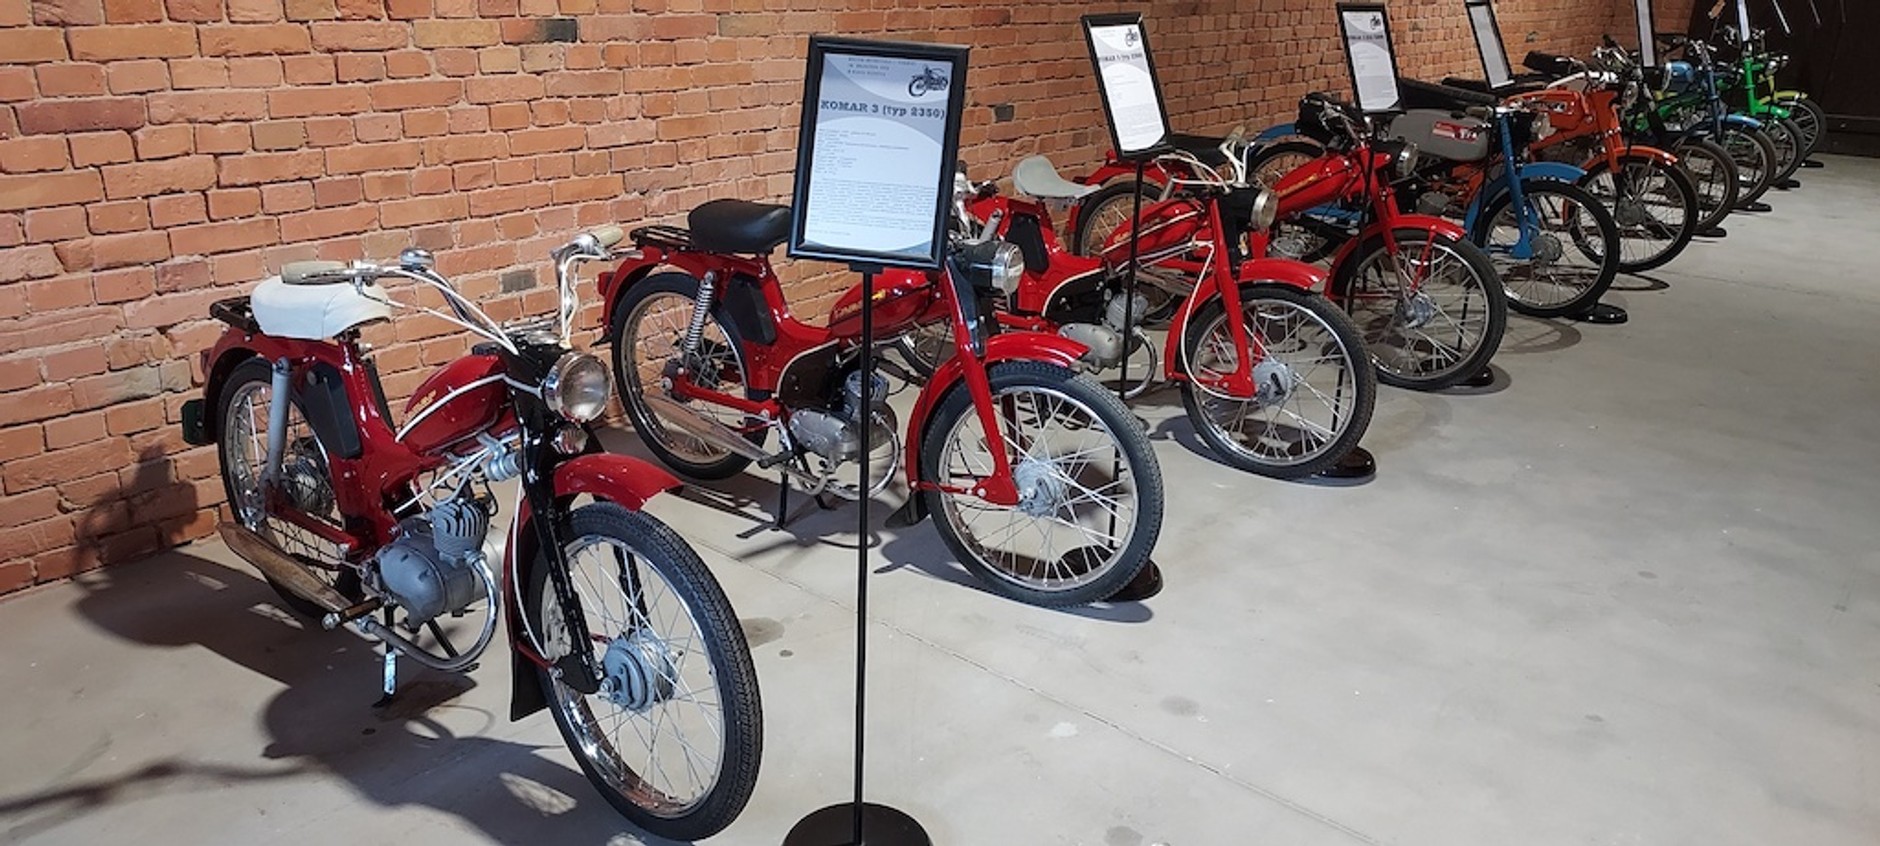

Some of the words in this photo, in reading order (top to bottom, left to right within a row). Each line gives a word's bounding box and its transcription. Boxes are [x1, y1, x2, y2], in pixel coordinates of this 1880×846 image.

[821, 100, 868, 113] KOMAR
[872, 104, 879, 113] 3
[883, 105, 907, 117] (typ
[911, 107, 945, 120] 2350)
